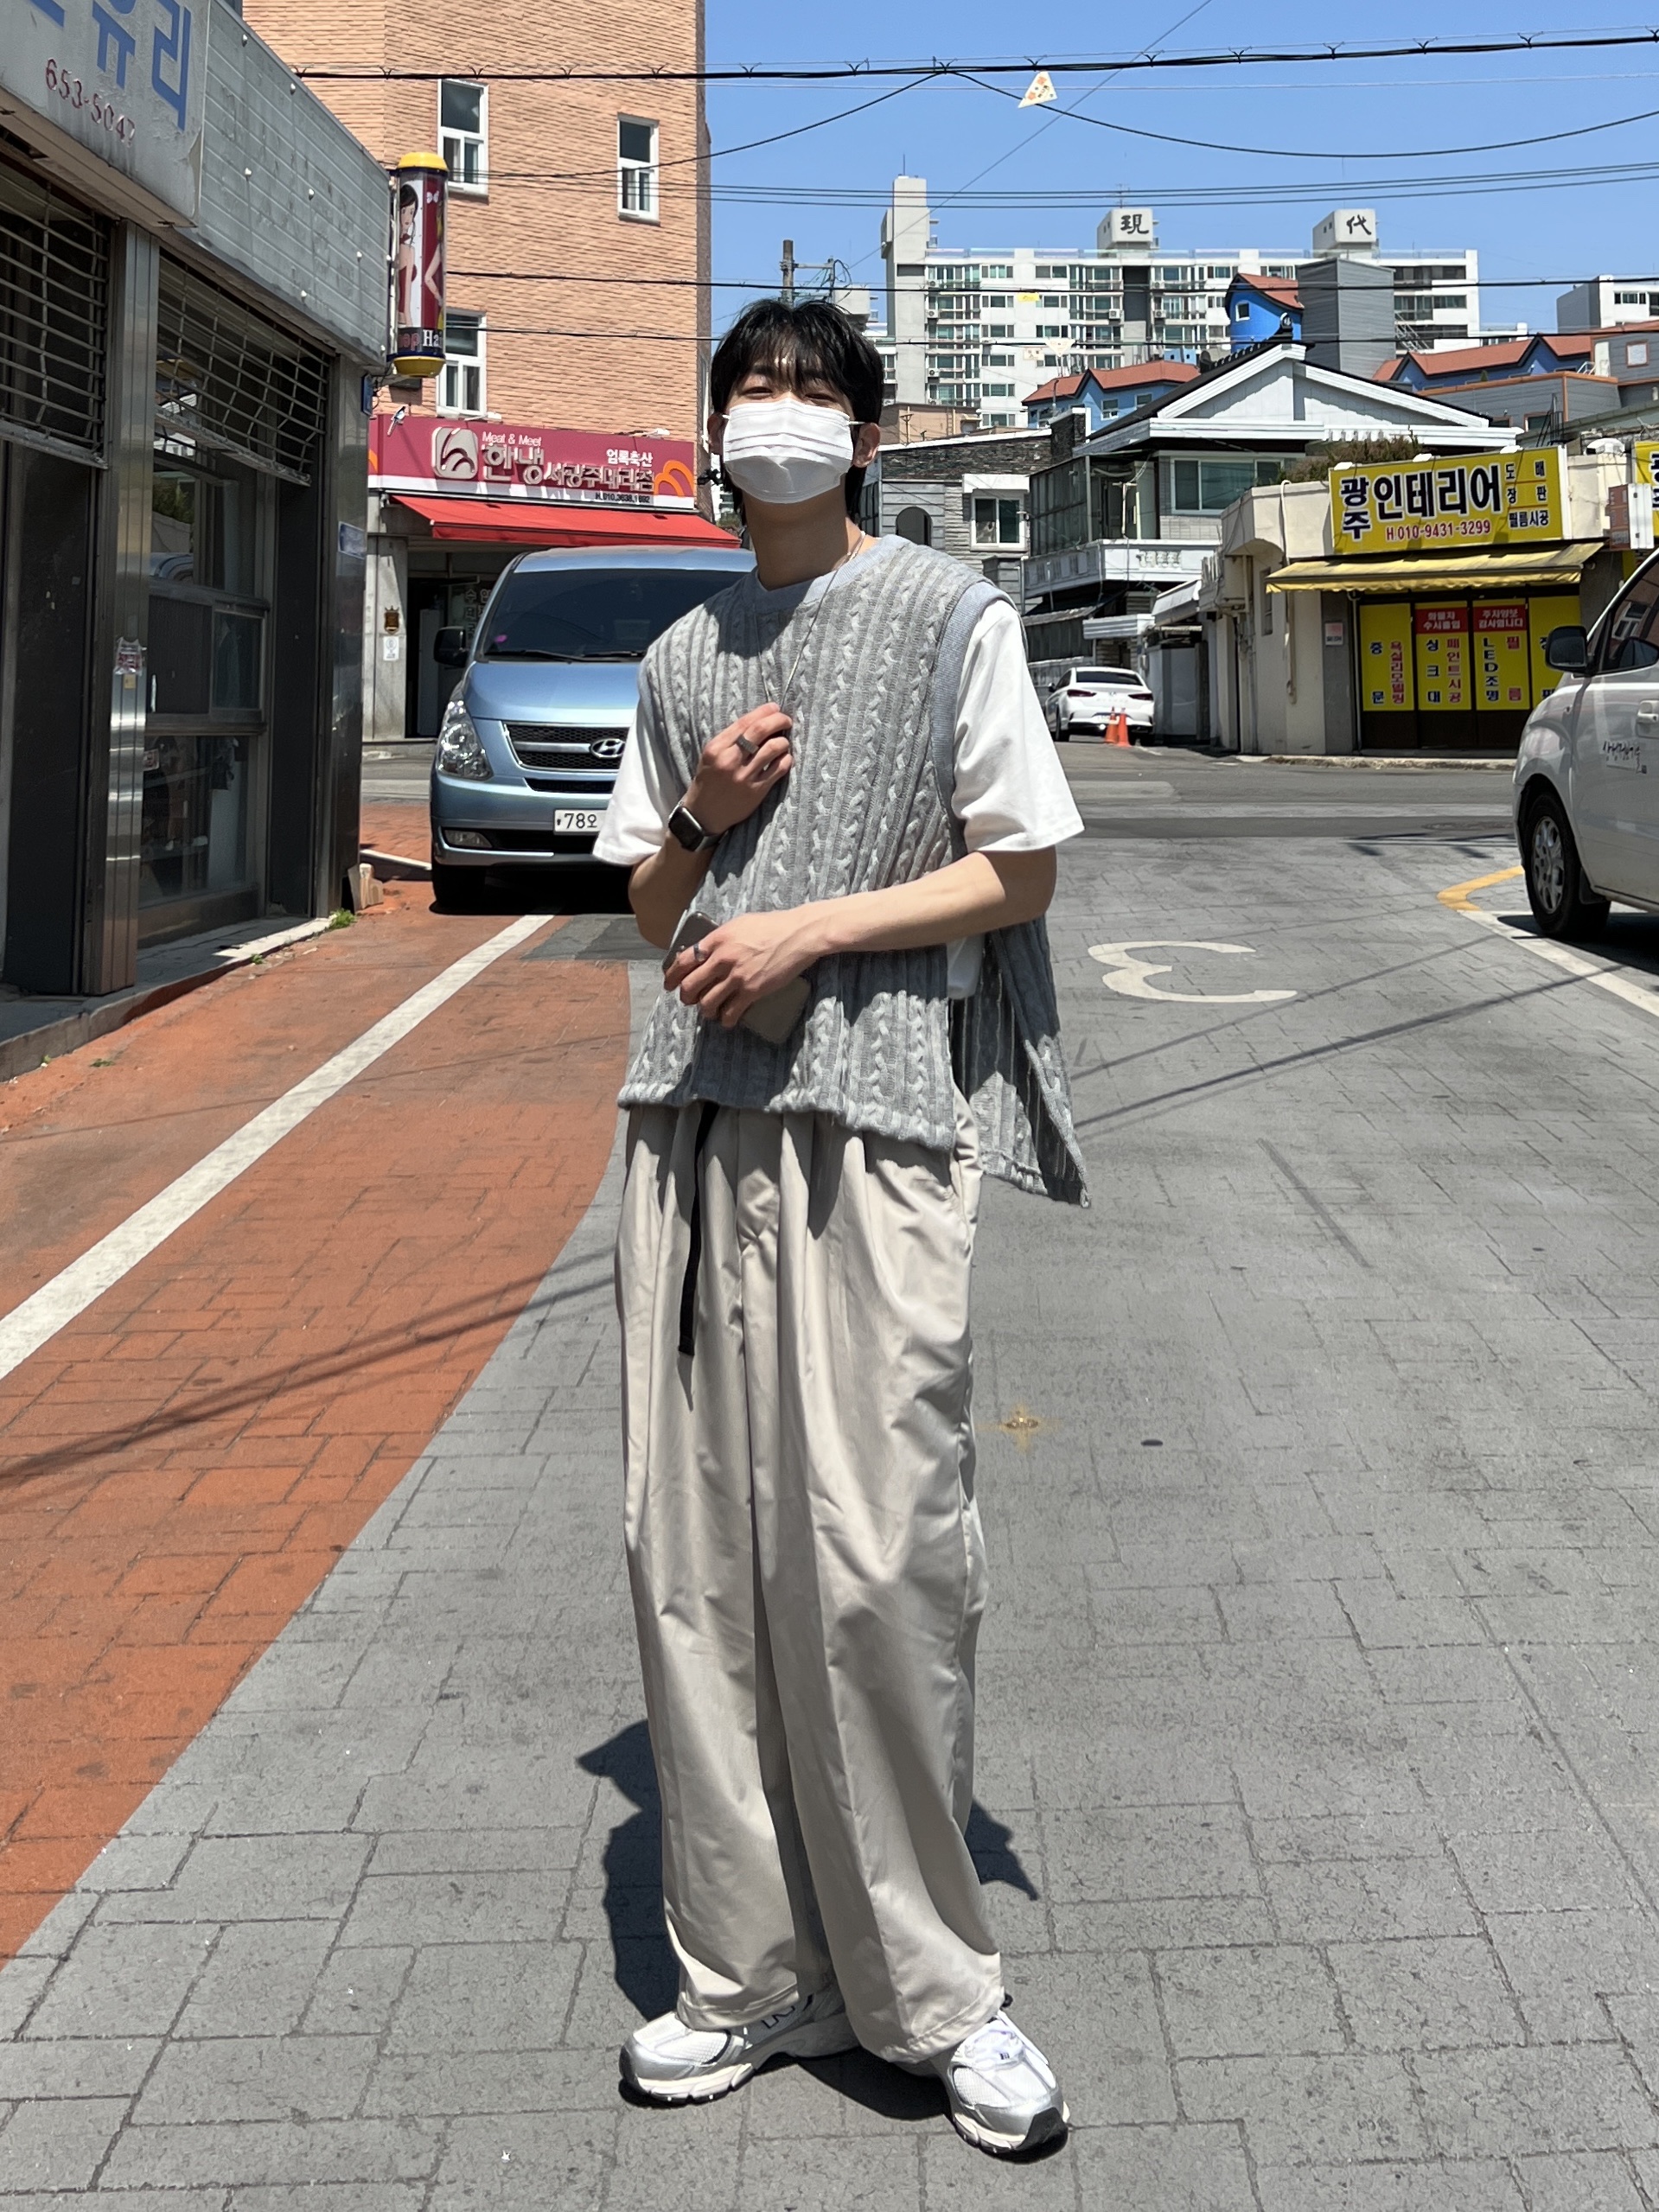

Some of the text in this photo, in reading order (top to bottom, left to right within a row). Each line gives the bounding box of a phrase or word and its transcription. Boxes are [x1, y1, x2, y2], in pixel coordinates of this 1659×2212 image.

[29, 0, 190, 131] 유리
[1120, 214, 1372, 235] 現 代
[482, 431, 506, 443] Meat
[508, 433, 516, 445] &
[1341, 465, 1501, 540] 광주 인테리어
[1509, 509, 1549, 528] 필름시공
[1426, 639, 1440, 703] 싱크대
[565, 813, 597, 829] 78오
